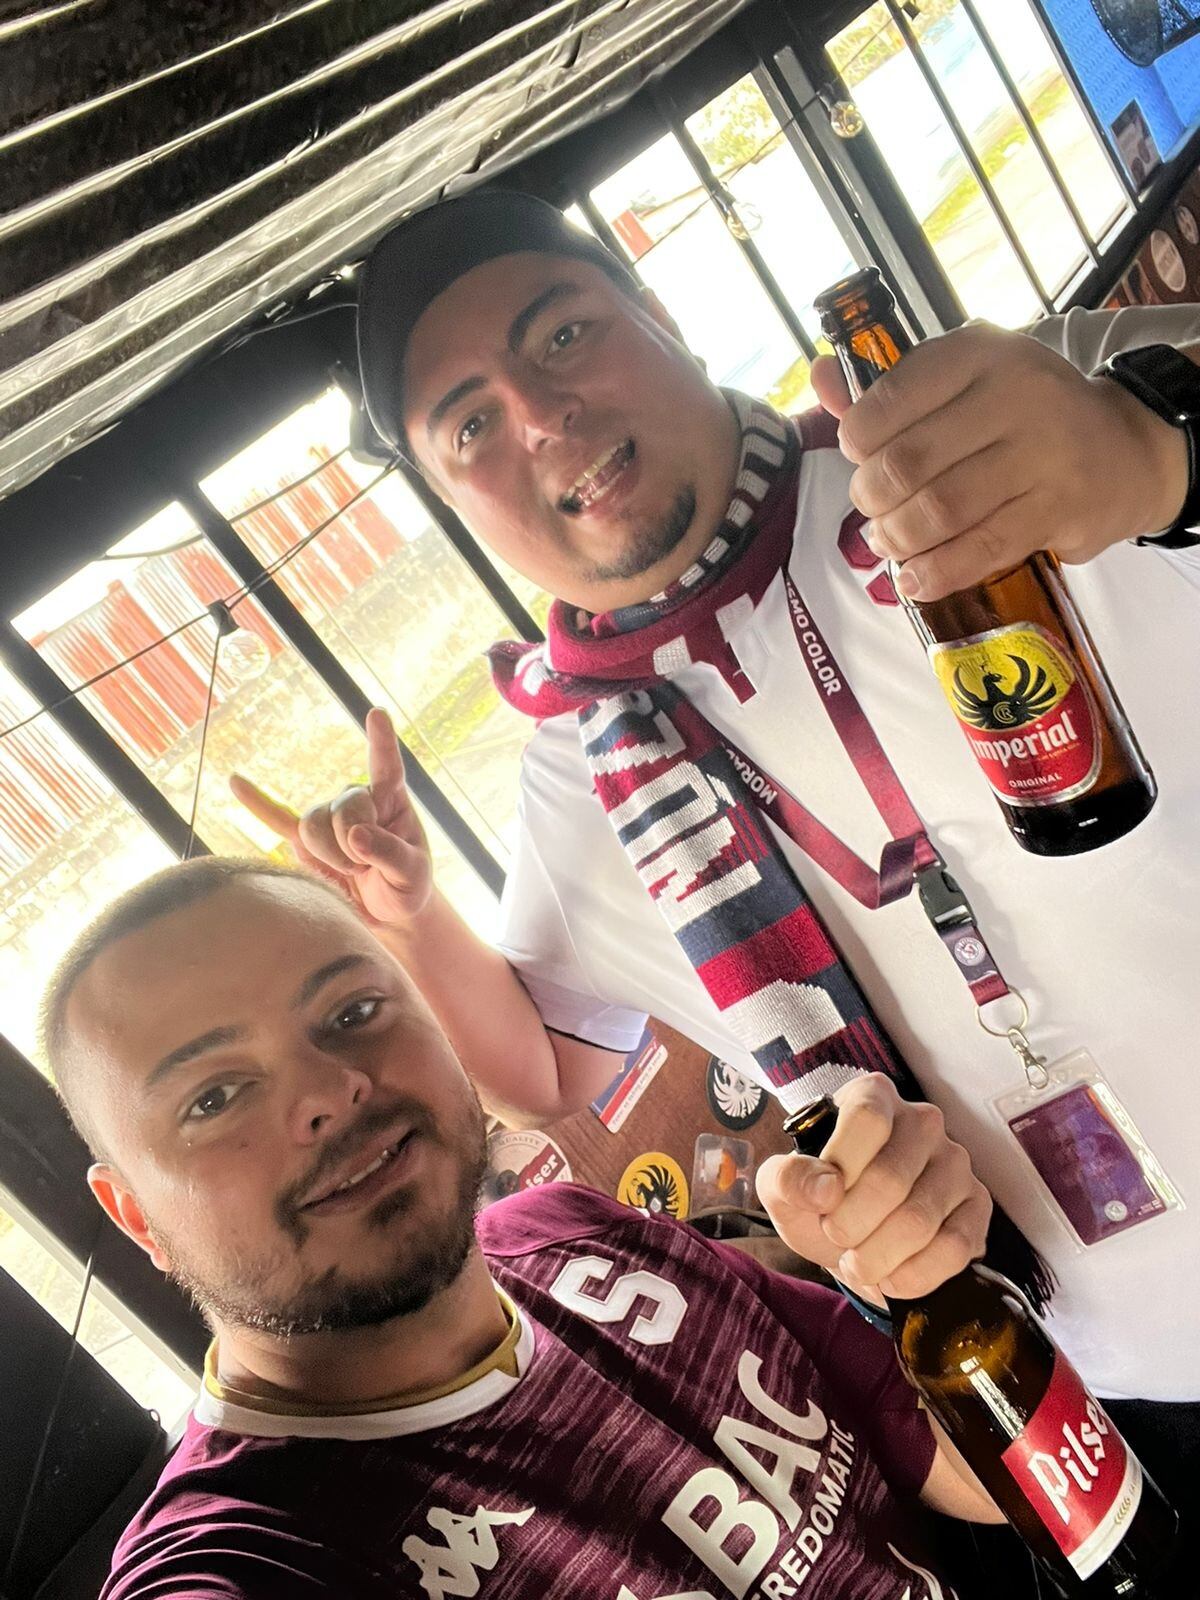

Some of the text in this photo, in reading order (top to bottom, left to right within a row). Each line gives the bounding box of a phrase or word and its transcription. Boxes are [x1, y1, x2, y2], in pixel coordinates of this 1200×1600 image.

[802, 631, 842, 697] COLOR
[1008, 772, 1063, 789] ORIGINAL
[548, 1255, 689, 1346] S
[661, 1349, 828, 1600] BAC
[751, 1418, 855, 1600] REDOMATIC
[1027, 1400, 1109, 1526] Pilse
